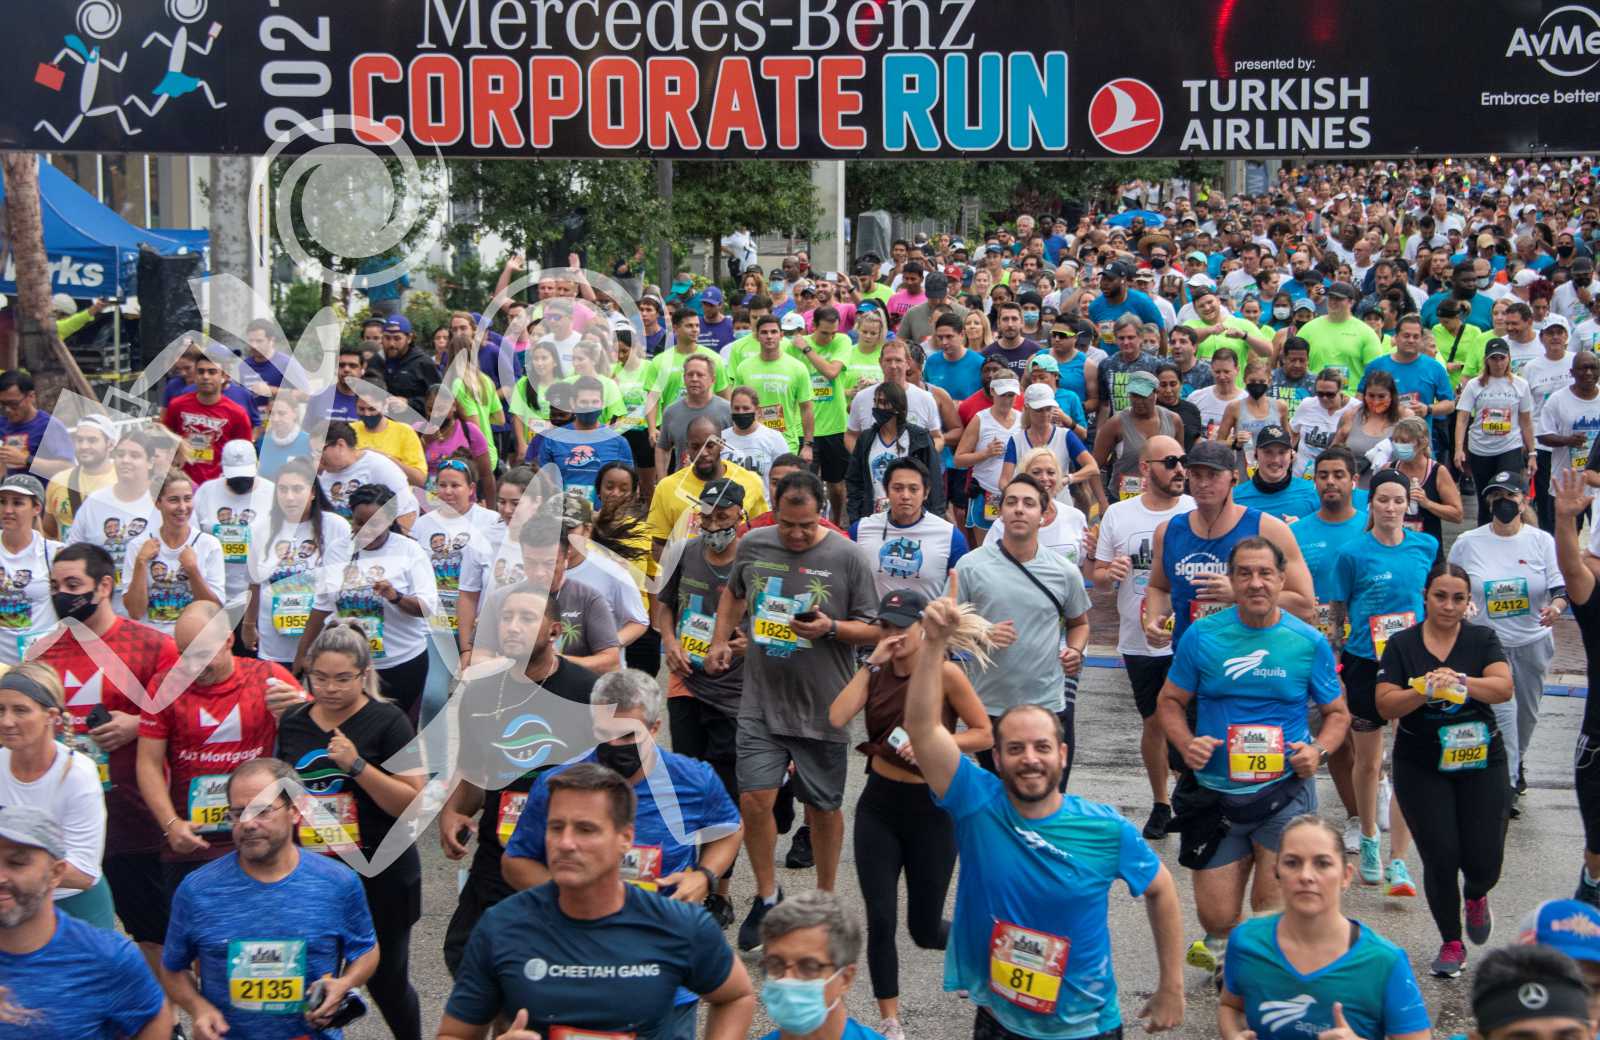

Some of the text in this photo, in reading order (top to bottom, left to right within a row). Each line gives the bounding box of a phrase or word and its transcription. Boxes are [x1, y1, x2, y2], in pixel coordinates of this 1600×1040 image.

[416, 0, 976, 51] Mercedes-Benz
[258, 0, 335, 143] 202
[1234, 57, 1317, 73] presented by:
[348, 50, 1069, 151] CORPORATE RUN
[1182, 76, 1370, 112] TURKISH
[1481, 92, 1550, 106] Embrace
[1180, 116, 1372, 151] AIRLINES
[1494, 599, 1523, 612] 2412
[279, 615, 309, 629] 1955
[760, 621, 792, 640] 1825
[1252, 665, 1287, 679] aquila
[199, 746, 263, 764] Mortgage
[1247, 755, 1267, 771] 78
[1450, 747, 1482, 763] 1992
[548, 963, 660, 978] CHEETAH GANG
[1009, 968, 1035, 993] 81
[240, 980, 293, 1000] 2135
